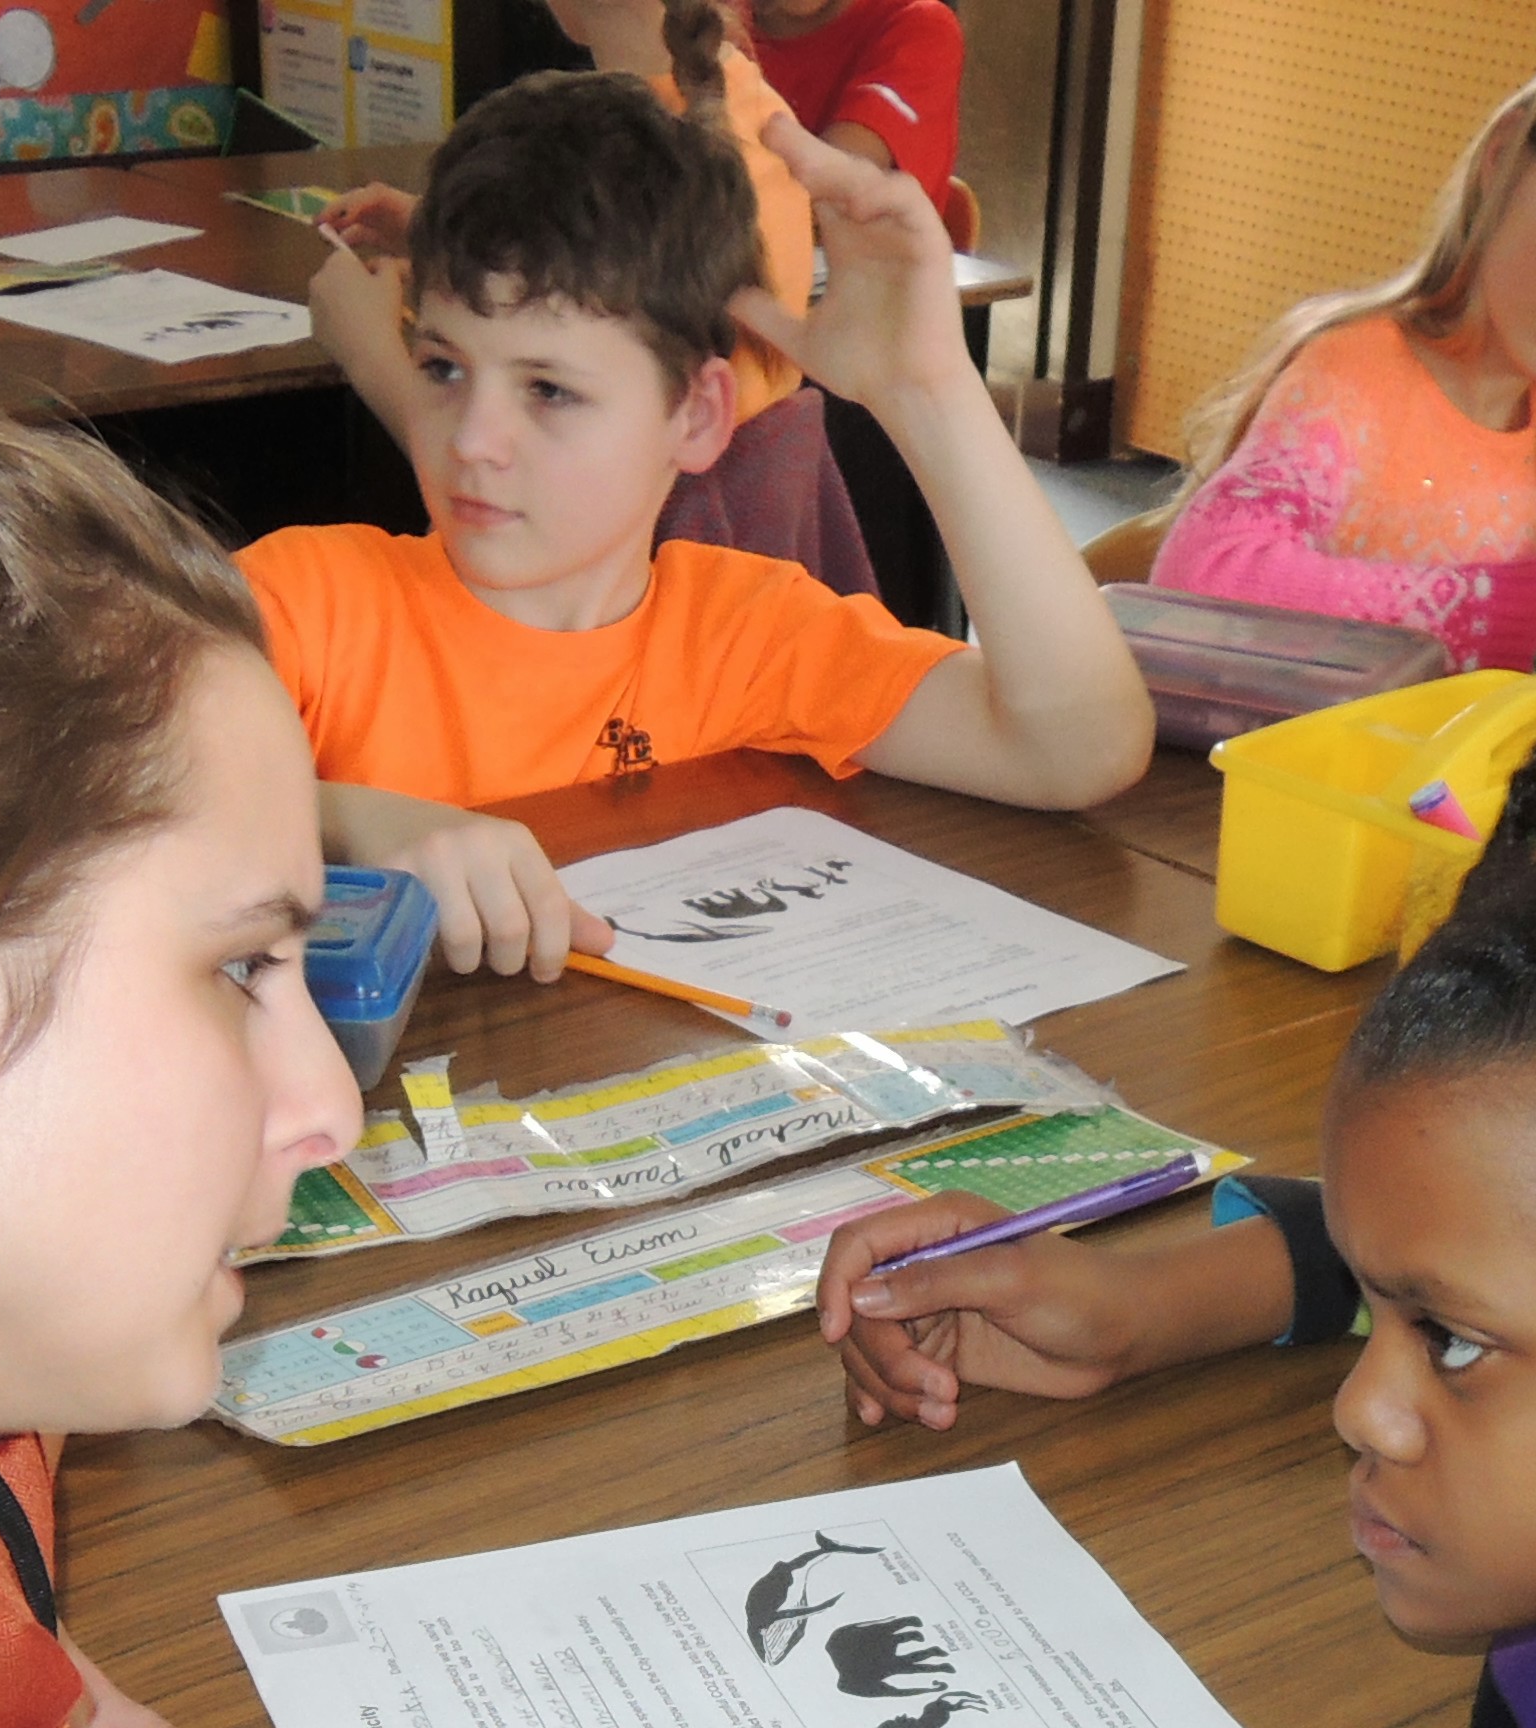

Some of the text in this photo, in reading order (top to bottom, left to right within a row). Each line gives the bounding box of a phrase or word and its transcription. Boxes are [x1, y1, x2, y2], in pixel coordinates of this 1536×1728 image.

[706, 1105, 856, 1168] Michael
[444, 1254, 568, 1310] Raquel
[945, 1531, 966, 1548] CO2
[961, 1548, 982, 1566] much
[977, 1566, 993, 1581] how
[639, 1582, 658, 1600] chart
[656, 1579, 678, 1605] Oberlin
[988, 1581, 1005, 1593] out
[653, 1600, 666, 1612] the
[966, 1596, 981, 1604] of
[998, 1593, 1016, 1607] find
[671, 1605, 690, 1622] CO2
[1011, 1606, 1024, 1616] to
[436, 1616, 453, 1636] much
[661, 1612, 676, 1627] Use
[682, 1622, 697, 1631] of
[418, 1619, 440, 1642] using?
[1017, 1616, 1055, 1654] Dashboard
[449, 1639, 463, 1652] too
[587, 1634, 601, 1645] far
[679, 1638, 693, 1652] the
[434, 1642, 451, 1662] we're
[594, 1644, 607, 1655] so
[628, 1642, 643, 1657] has
[458, 1655, 473, 1669] use
[637, 1656, 652, 1672] City
[687, 1651, 702, 1665] into
[703, 1649, 729, 1676] pounds
[467, 1672, 479, 1681] to
[601, 1655, 627, 1688] electricity
[646, 1671, 661, 1684] the
[696, 1664, 714, 1679] gas
[1050, 1654, 1097, 1705] Environmental
[445, 1663, 470, 1697] electricity
[723, 1677, 741, 1699] many
[1023, 1664, 1054, 1696] released
[472, 1684, 487, 1697] not
[621, 1688, 635, 1699] on
[653, 1684, 674, 1706] much
[703, 1679, 723, 1698] CO2
[1092, 1682, 1119, 1709] actually
[462, 1698, 480, 1719] much
[626, 1699, 648, 1722] spent
[737, 1700, 753, 1716] how
[1049, 1695, 1066, 1711] has
[669, 1705, 685, 1722] how
[715, 1698, 741, 1726] harmful
[1093, 1705, 1109, 1720] the
[1115, 1710, 1132, 1726] has
